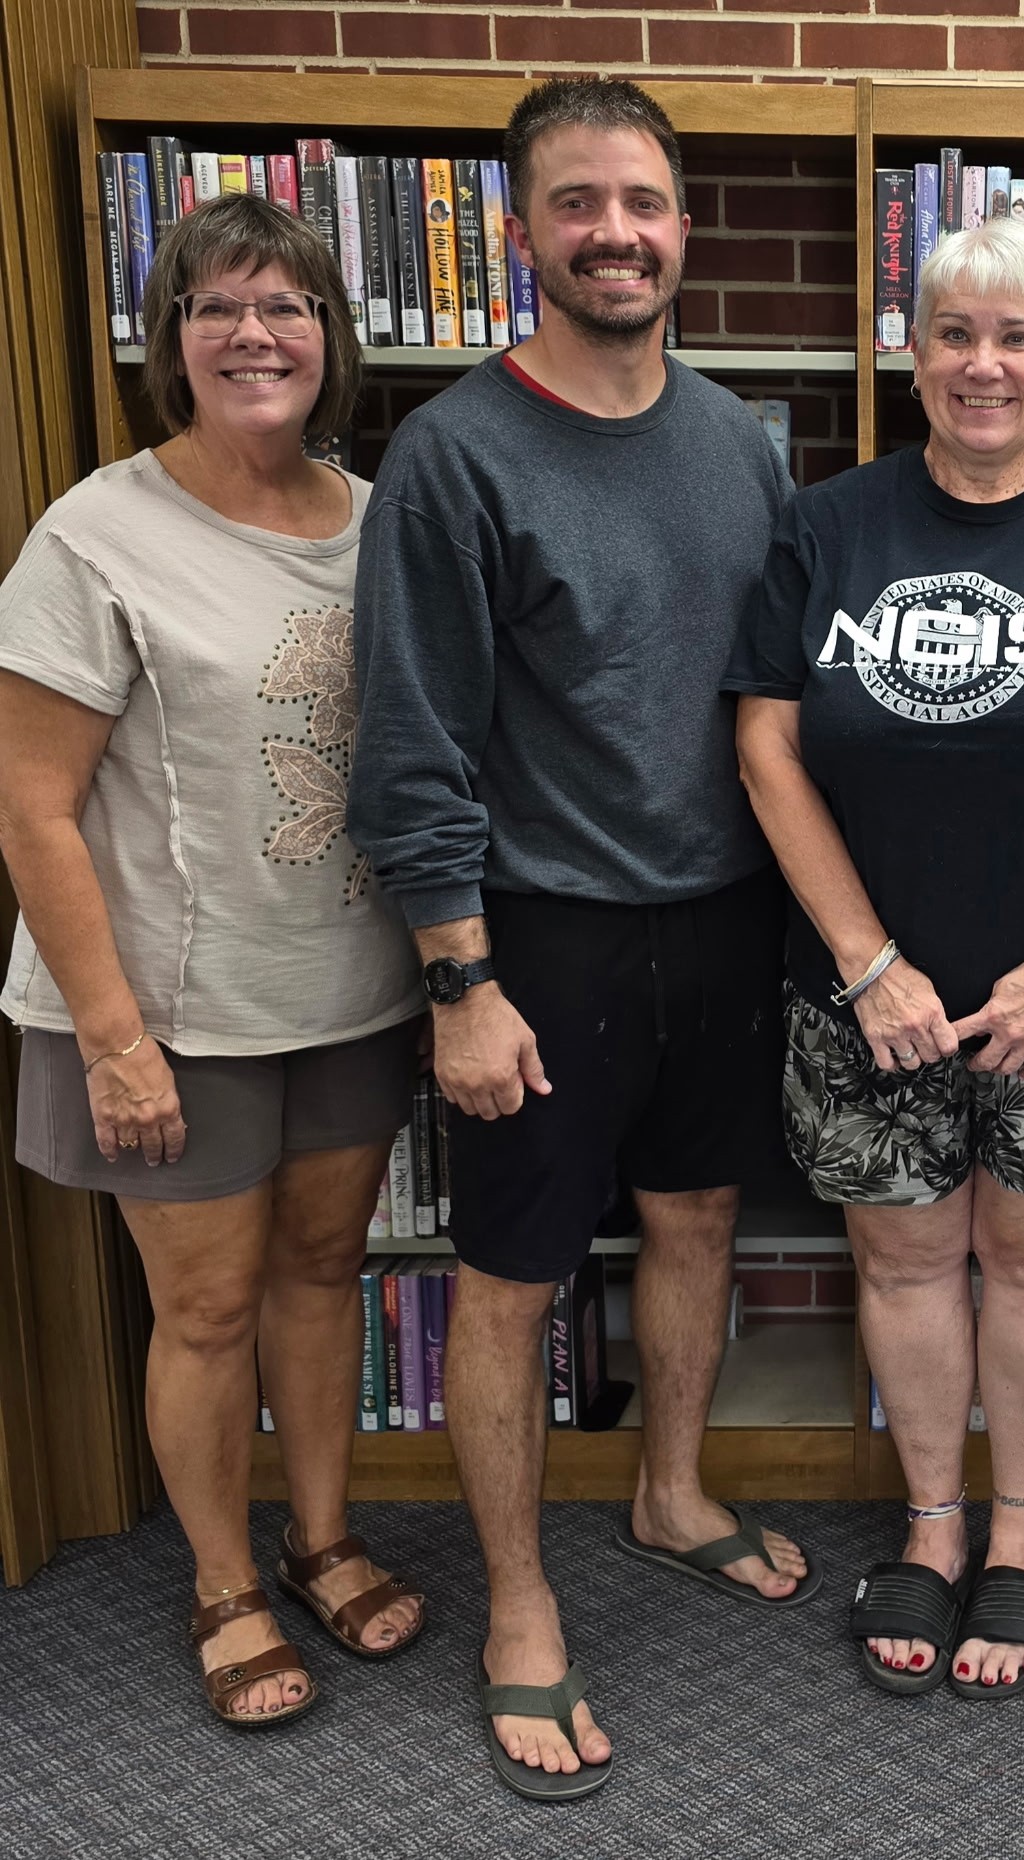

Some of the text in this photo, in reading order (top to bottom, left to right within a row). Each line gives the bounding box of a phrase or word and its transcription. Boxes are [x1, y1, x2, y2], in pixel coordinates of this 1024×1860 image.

[437, 169, 446, 195] SAMIRA
[947, 160, 955, 179] LOST
[105, 177, 116, 220] DARE ME
[400, 190, 411, 245] THIEF'S
[459, 210, 475, 218] THE
[887, 201, 904, 229] Red
[946, 197, 954, 223] FOUND
[342, 222, 356, 247] Red
[368, 197, 380, 268] ASSASSIN'S
[459, 229, 479, 237] WOOD
[486, 208, 500, 258] Amelia,
[921, 209, 934, 238] Alma
[109, 231, 122, 305] MEGAN ABBOTT
[343, 249, 358, 288] Ribbon
[428, 228, 454, 281] HOLLOW
[881, 232, 909, 283] Knight
[405, 252, 415, 308] CUNNIN
[523, 288, 532, 304] SO
[862, 583, 908, 630] UNITED
[910, 574, 965, 592] STATES
[968, 575, 989, 590] OF
[862, 668, 950, 722] SPECIAL
[393, 1130, 406, 1163] RUEL
[362, 1353, 373, 1382] SAME
[552, 1318, 569, 1392] PLAN A
[388, 1343, 397, 1407] CHLORINE SK
[404, 1365, 415, 1402] LOVES
